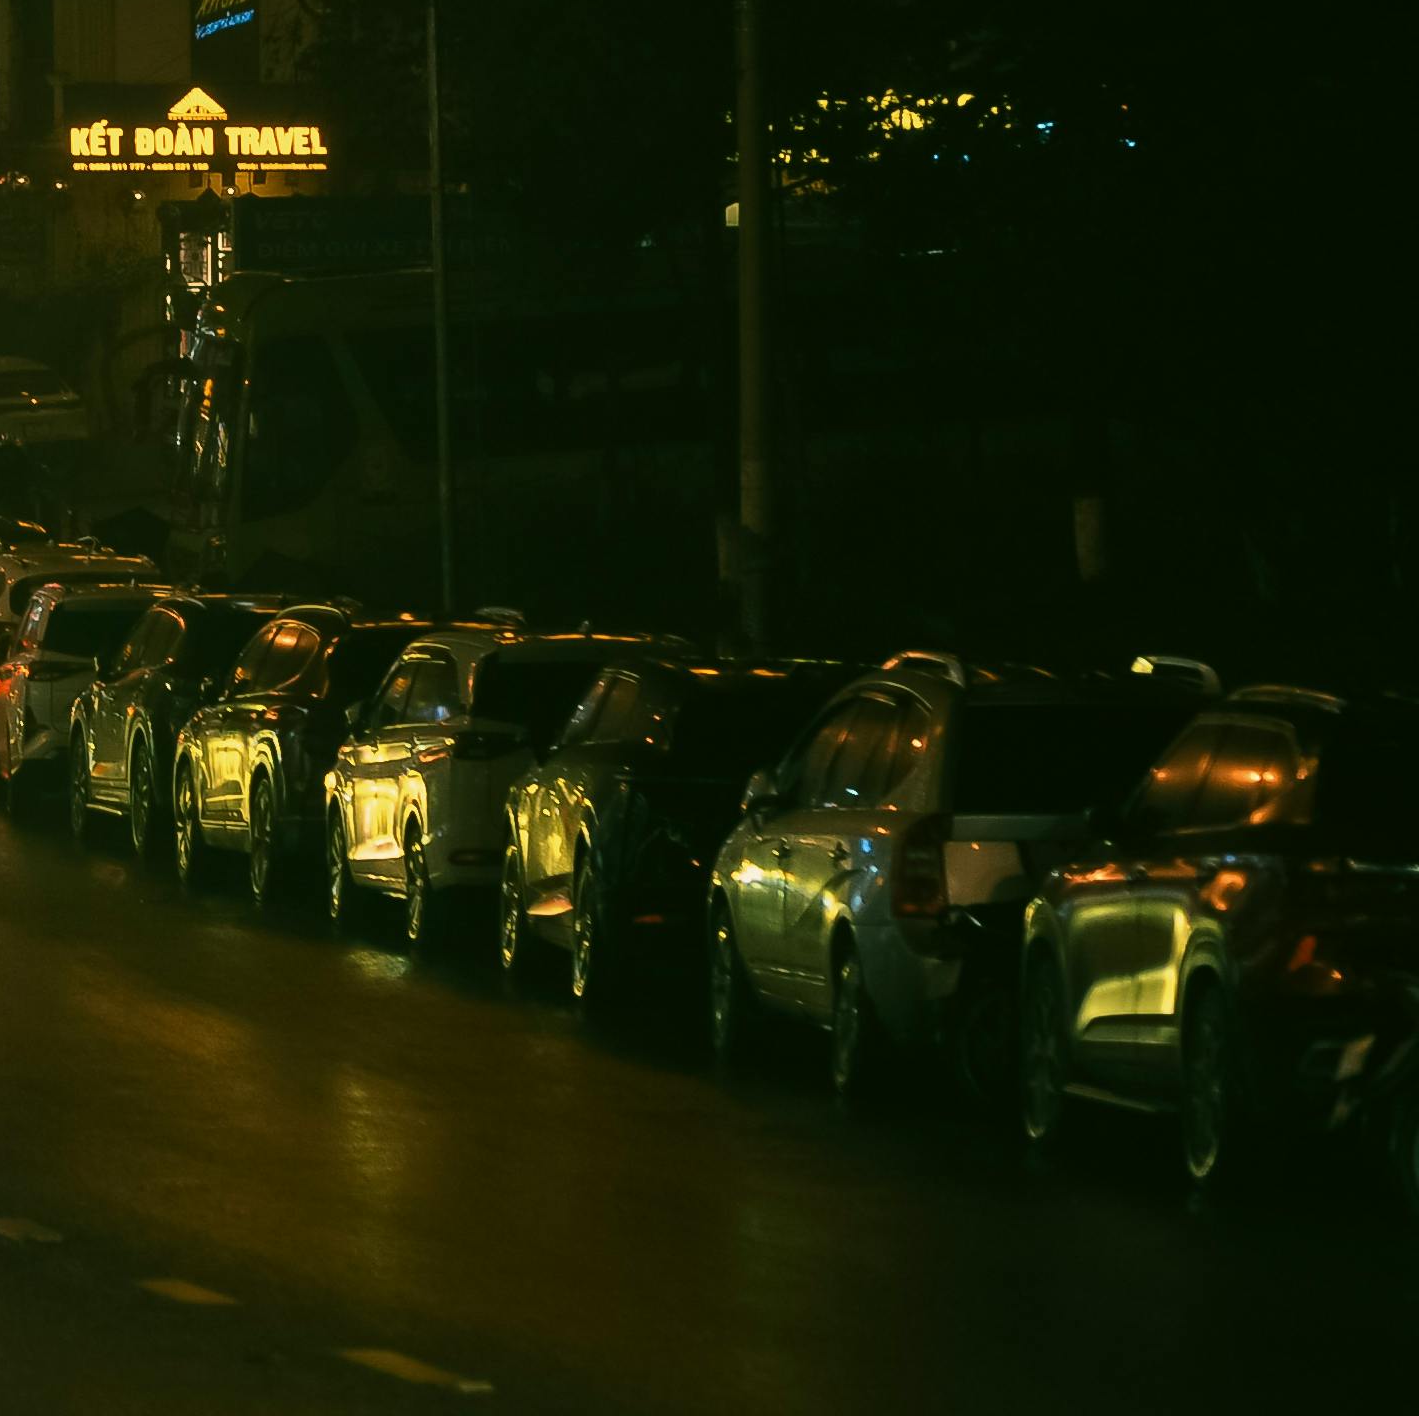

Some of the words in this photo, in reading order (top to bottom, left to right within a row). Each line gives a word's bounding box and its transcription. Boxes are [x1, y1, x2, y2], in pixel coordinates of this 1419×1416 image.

[70, 118, 124, 156] KẾT
[134, 122, 214, 156] ĐOÀN
[224, 126, 328, 156] TRAVEL
